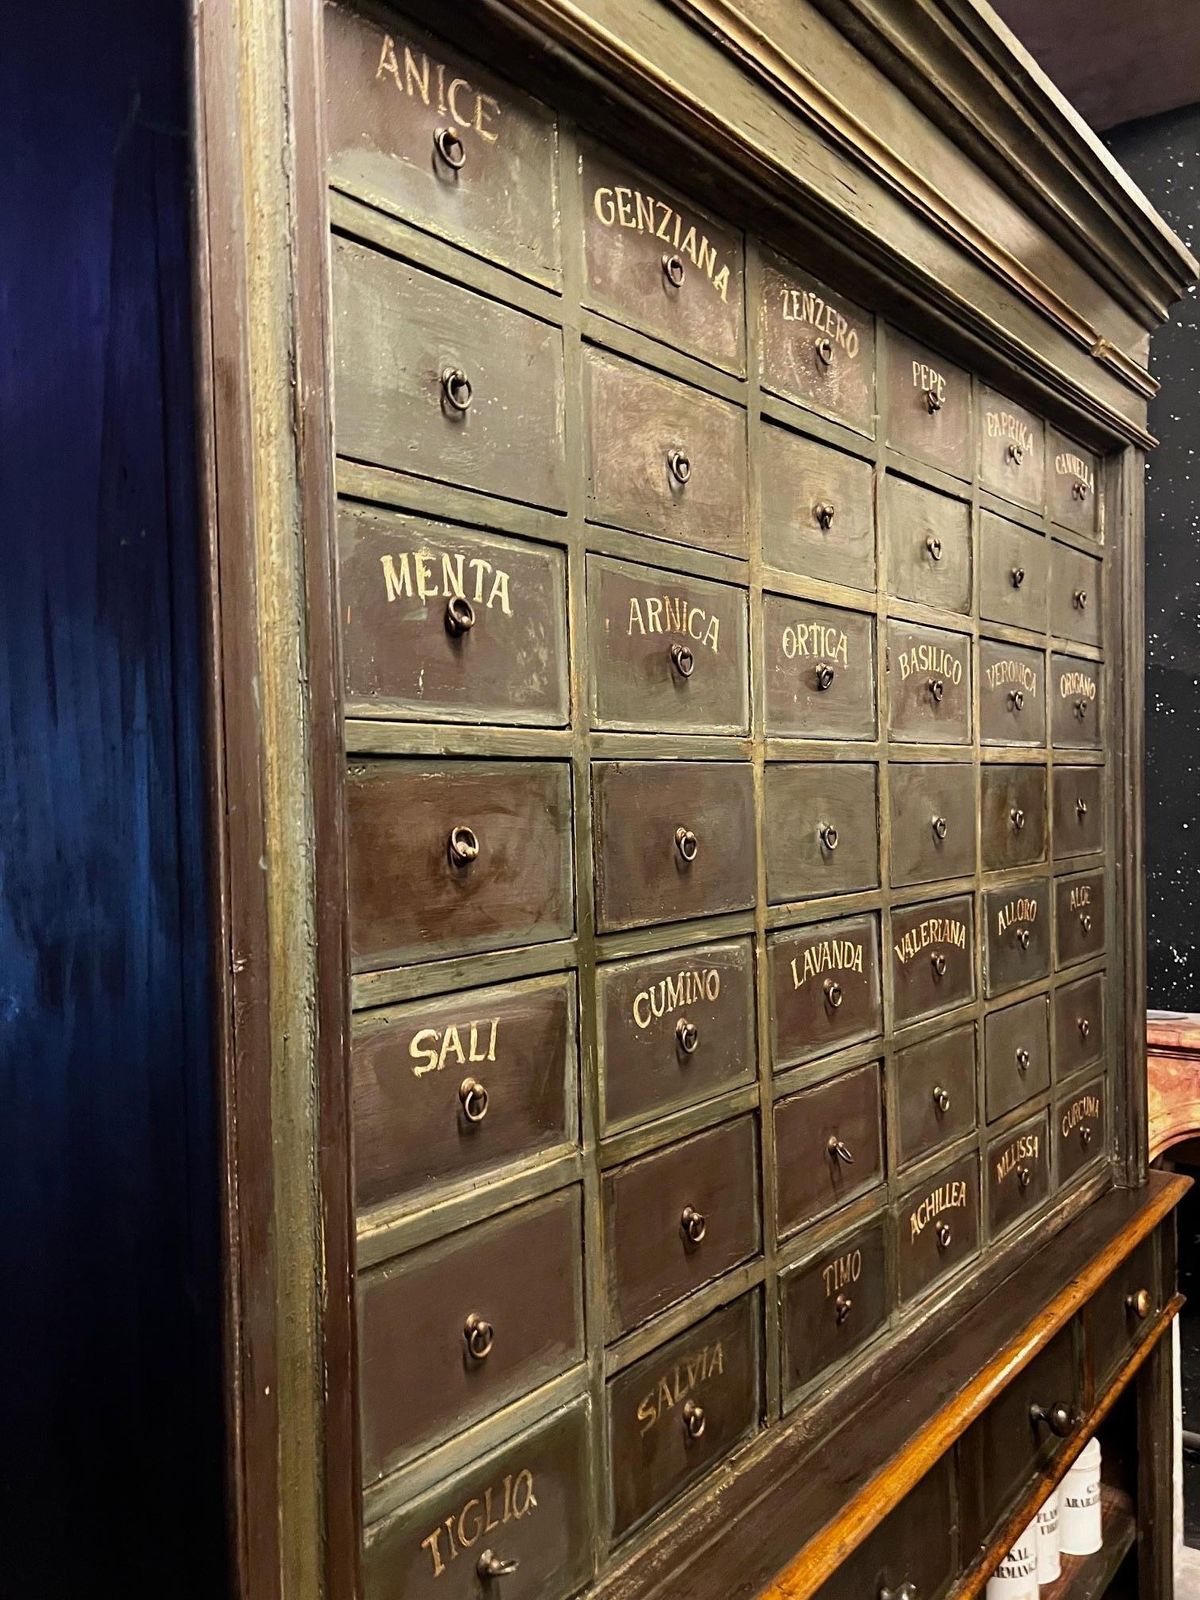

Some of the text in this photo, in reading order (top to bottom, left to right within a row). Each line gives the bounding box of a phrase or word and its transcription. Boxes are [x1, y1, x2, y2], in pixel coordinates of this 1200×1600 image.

[376, 34, 501, 143] ANICE
[594, 187, 731, 303] GENZIANA
[780, 286, 859, 360] ZENZERO
[912, 361, 946, 403] PEPE
[985, 411, 1034, 456] PAPRIKA
[380, 550, 513, 616] MENTA
[627, 595, 720, 654] ARNICA
[782, 622, 849, 669] ORTICA
[898, 644, 962, 685] BASILICO
[986, 660, 1037, 697] VERONICA
[1060, 672, 1096, 700] ORIGANO
[998, 898, 1038, 936] ALLORO
[1070, 886, 1091, 912] ALOE
[790, 940, 863, 990] LAVANDA
[894, 918, 966, 964] VALERIANA
[632, 969, 721, 1029] CUMINO
[408, 1017, 501, 1077] SALI
[1062, 1096, 1100, 1138] CURCUMA
[996, 1135, 1039, 1184] MELISSA
[909, 1181, 967, 1245] ACHILLEA
[822, 1249, 862, 1297] TIMO
[637, 1341, 724, 1437] SALVIA
